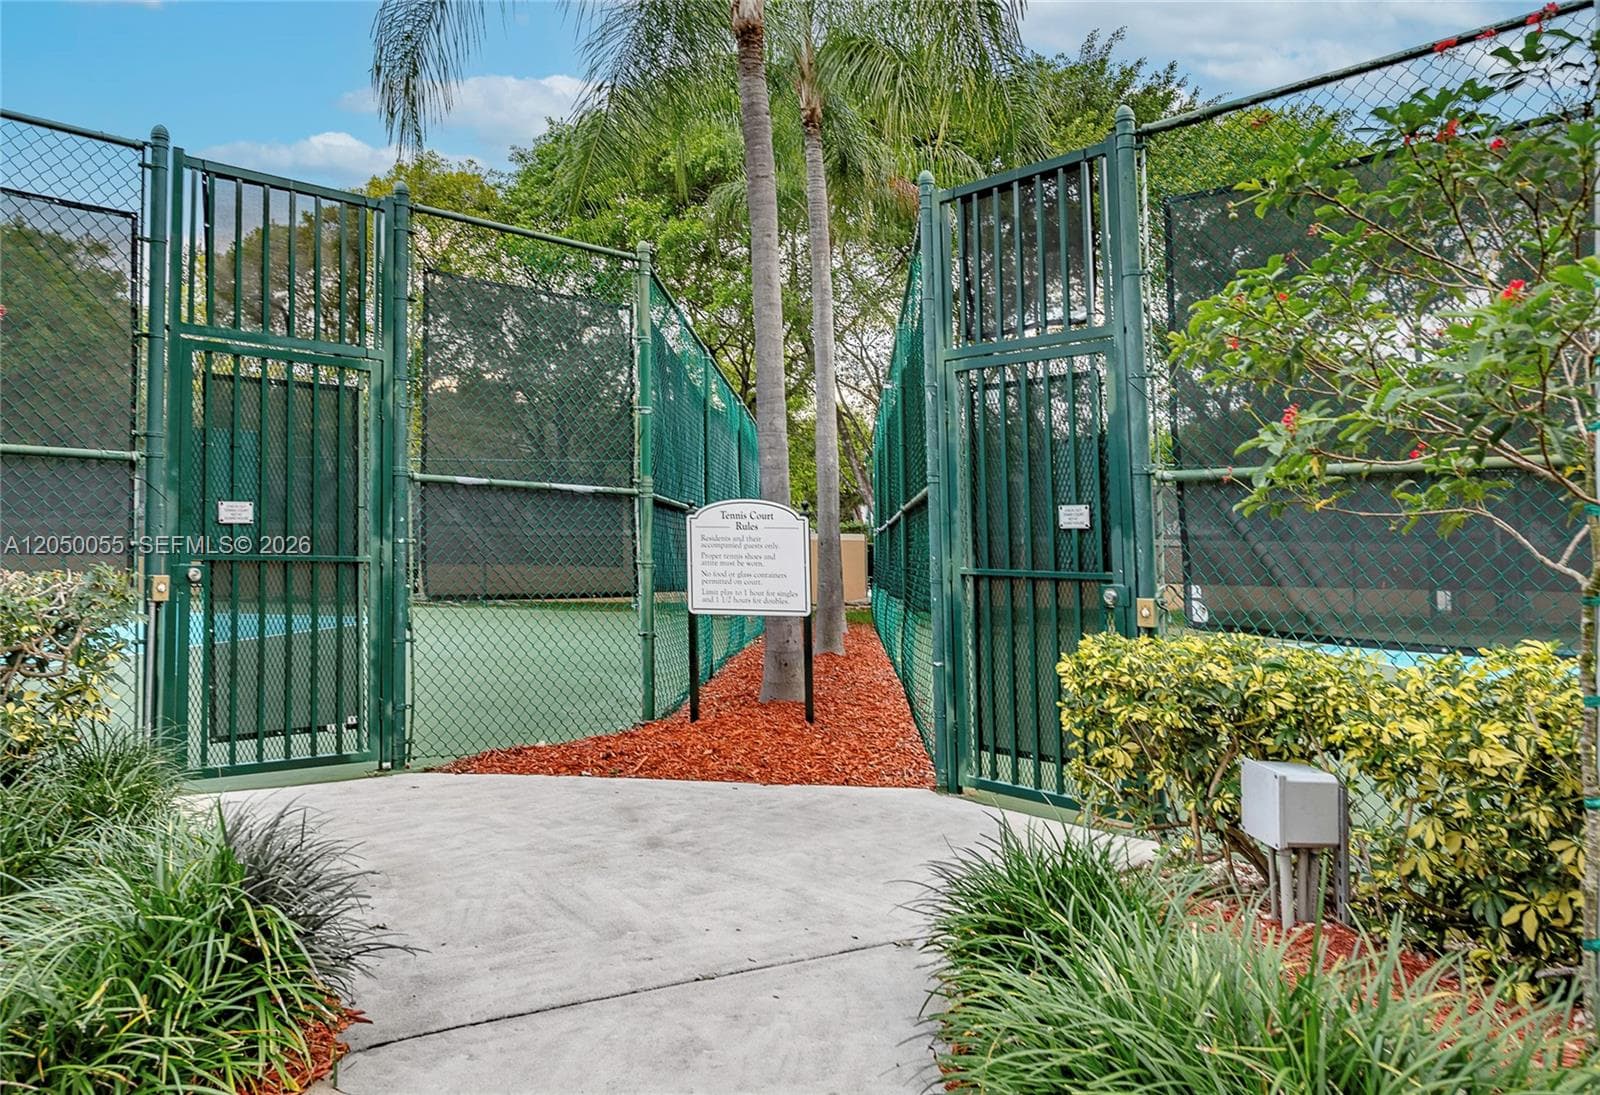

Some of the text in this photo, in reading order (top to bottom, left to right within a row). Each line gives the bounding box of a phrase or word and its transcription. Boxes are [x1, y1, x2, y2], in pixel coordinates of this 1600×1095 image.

[720, 511, 774, 520] Tennis Court
[736, 522, 758, 530] Rules
